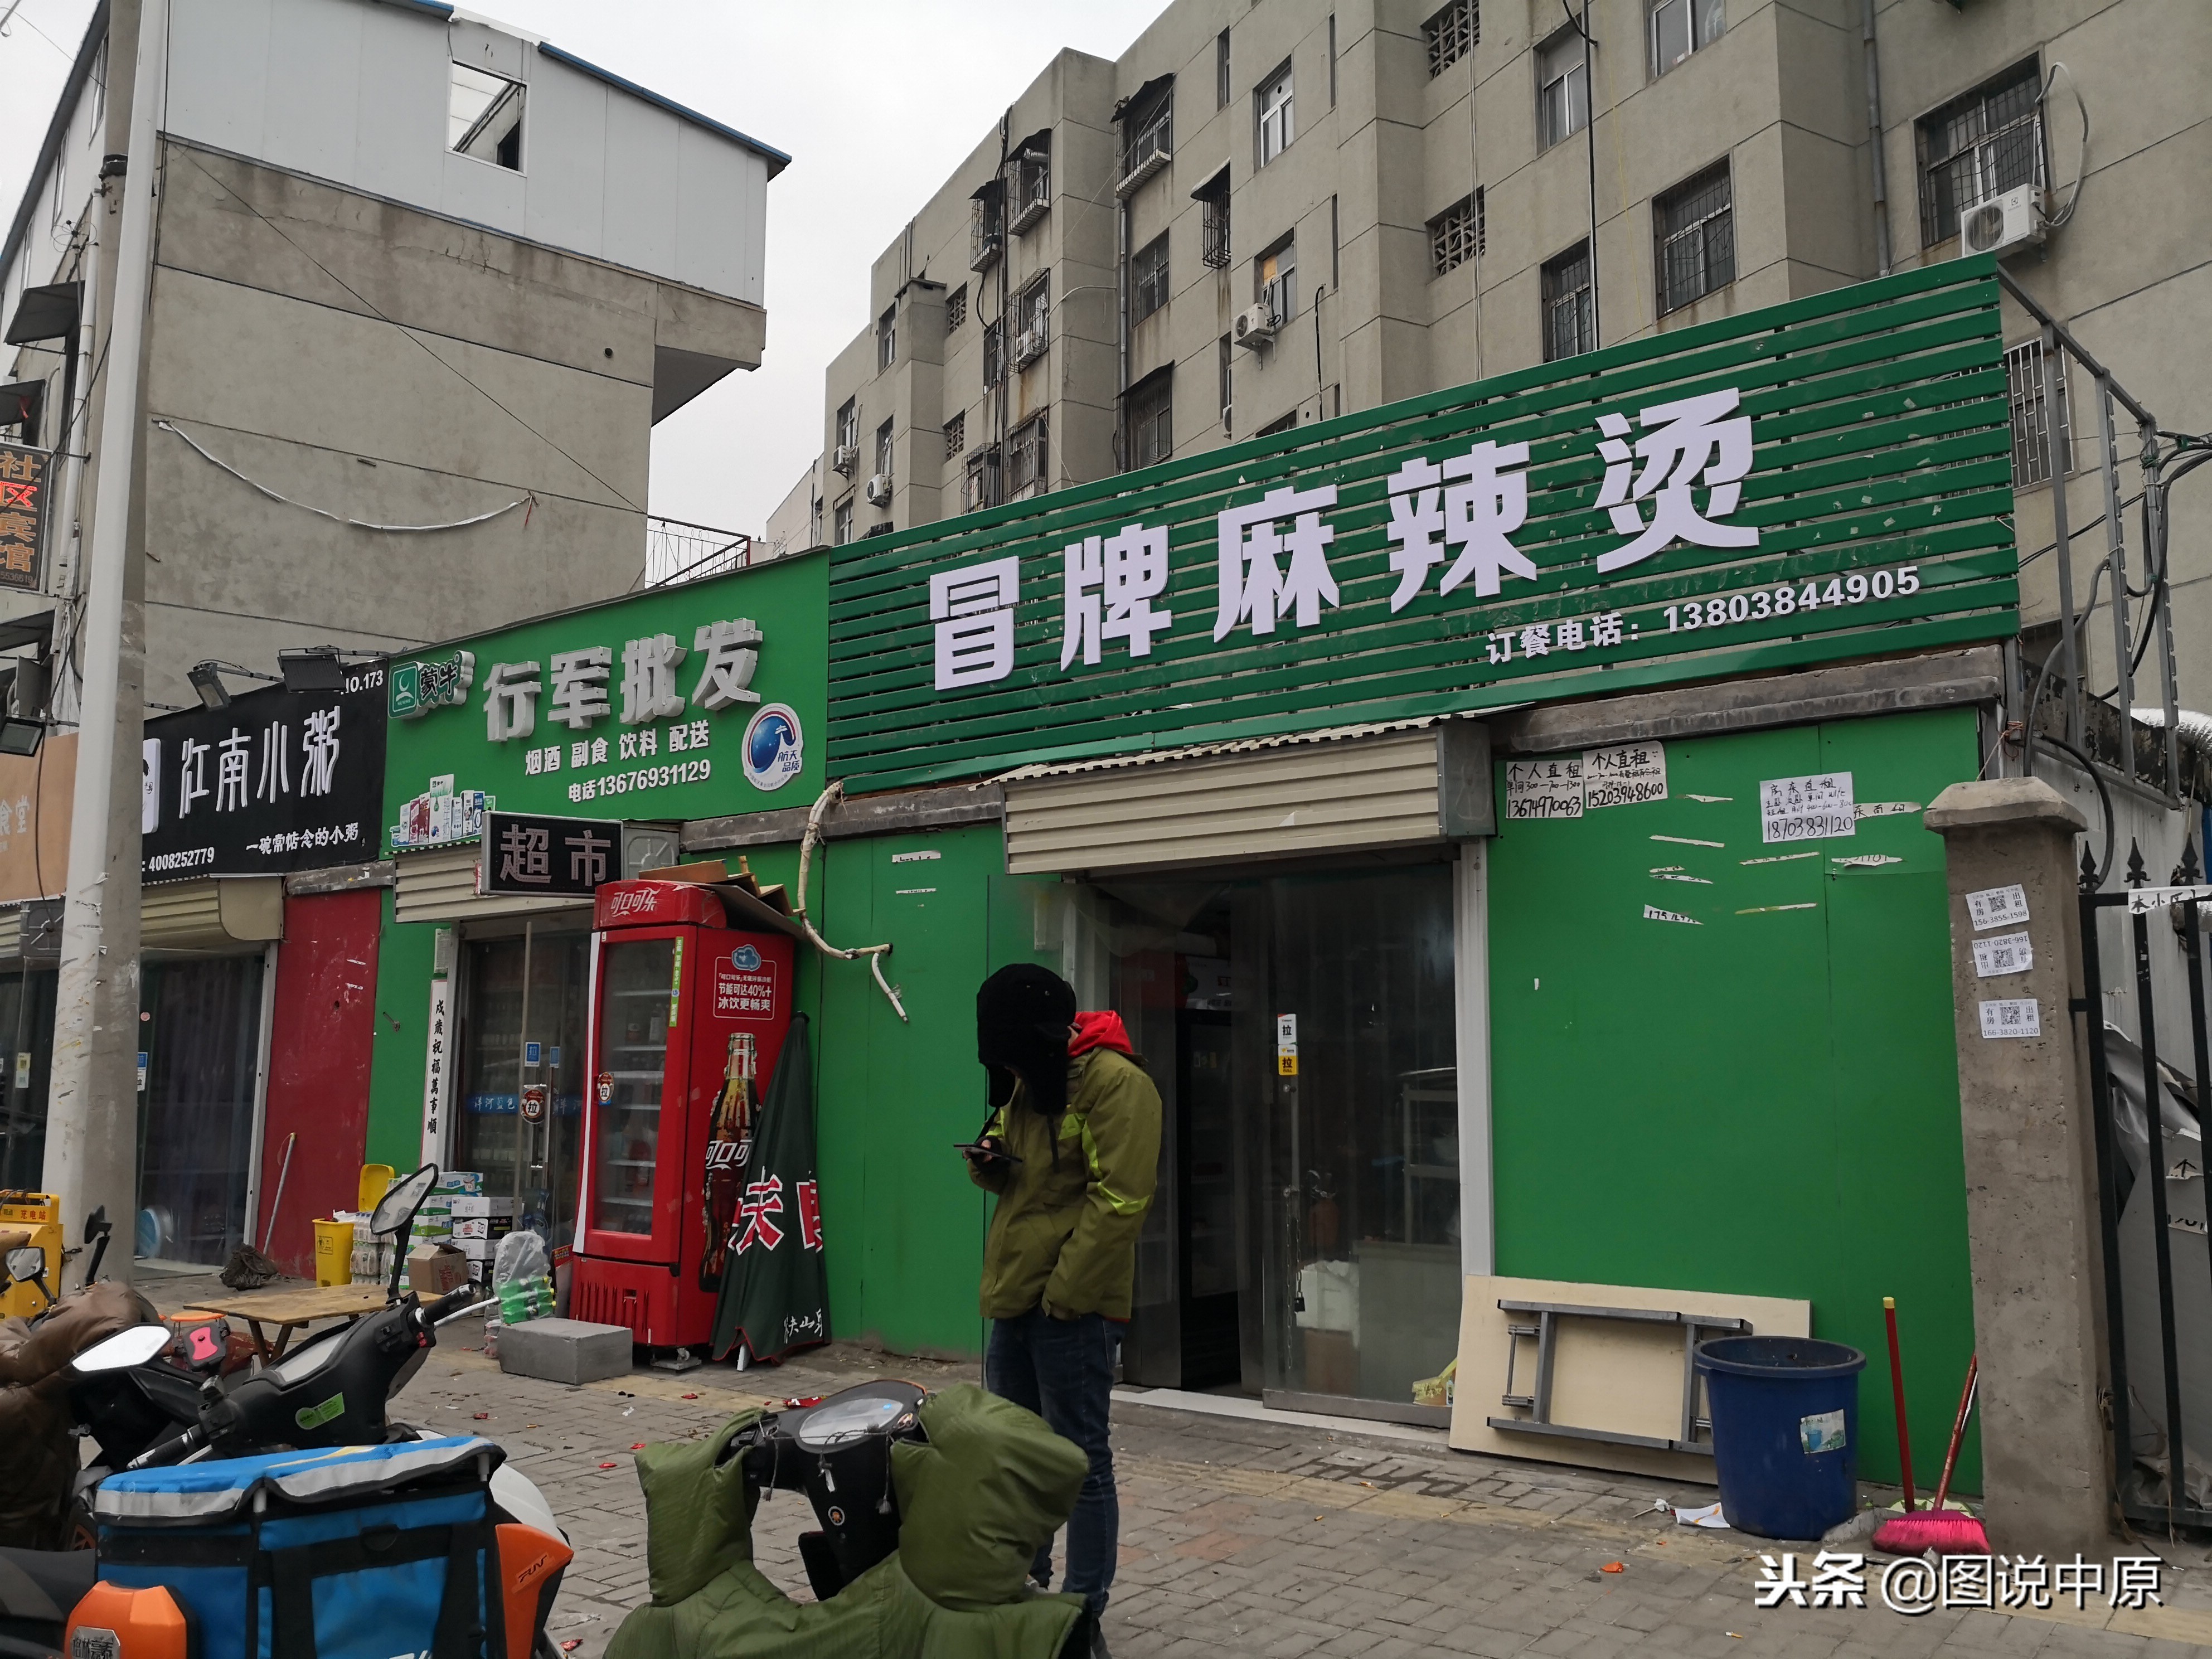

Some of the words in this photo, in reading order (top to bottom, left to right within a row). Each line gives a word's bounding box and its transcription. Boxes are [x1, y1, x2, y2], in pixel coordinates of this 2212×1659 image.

[929, 389, 1760, 692] 冒牌麻辣烫
[1663, 565, 1920, 633] 13803844905
[420, 662, 458, 701] 蒙牛
[483, 617, 763, 743] 行军批发
[525, 745, 561, 776] 烟酒
[570, 737, 609, 769] 副食
[619, 727, 658, 761] 饮料
[669, 719, 710, 753] 配送
[777, 749, 798, 763] 航天
[179, 705, 341, 819] 江南小粥
[782, 760, 800, 773] 品质
[1507, 762, 1583, 782] 个人直租
[1588, 783, 1664, 807] 15203948600
[1767, 815, 1854, 841] 18703831120
[246, 822, 359, 855] 一碗常惦念的小粥
[499, 823, 612, 887] 超市
[611, 886, 662, 918] 可口可乐
[1974, 910, 2027, 926] 156-3855-1598
[1973, 935, 2027, 949] 166-3820-1120
[718, 982, 772, 998] 节能可达40%+
[717, 996, 771, 1012] 冰饮更畅爽
[1282, 1025, 1292, 1036] 拉
[1983, 1027, 2039, 1036] 166-3820-1120
[1282, 1057, 1293, 1068] 拉
[601, 1086, 608, 1098] 拉
[527, 1102, 538, 1114] 拉
[21, 1209, 47, 1221] 充电站
